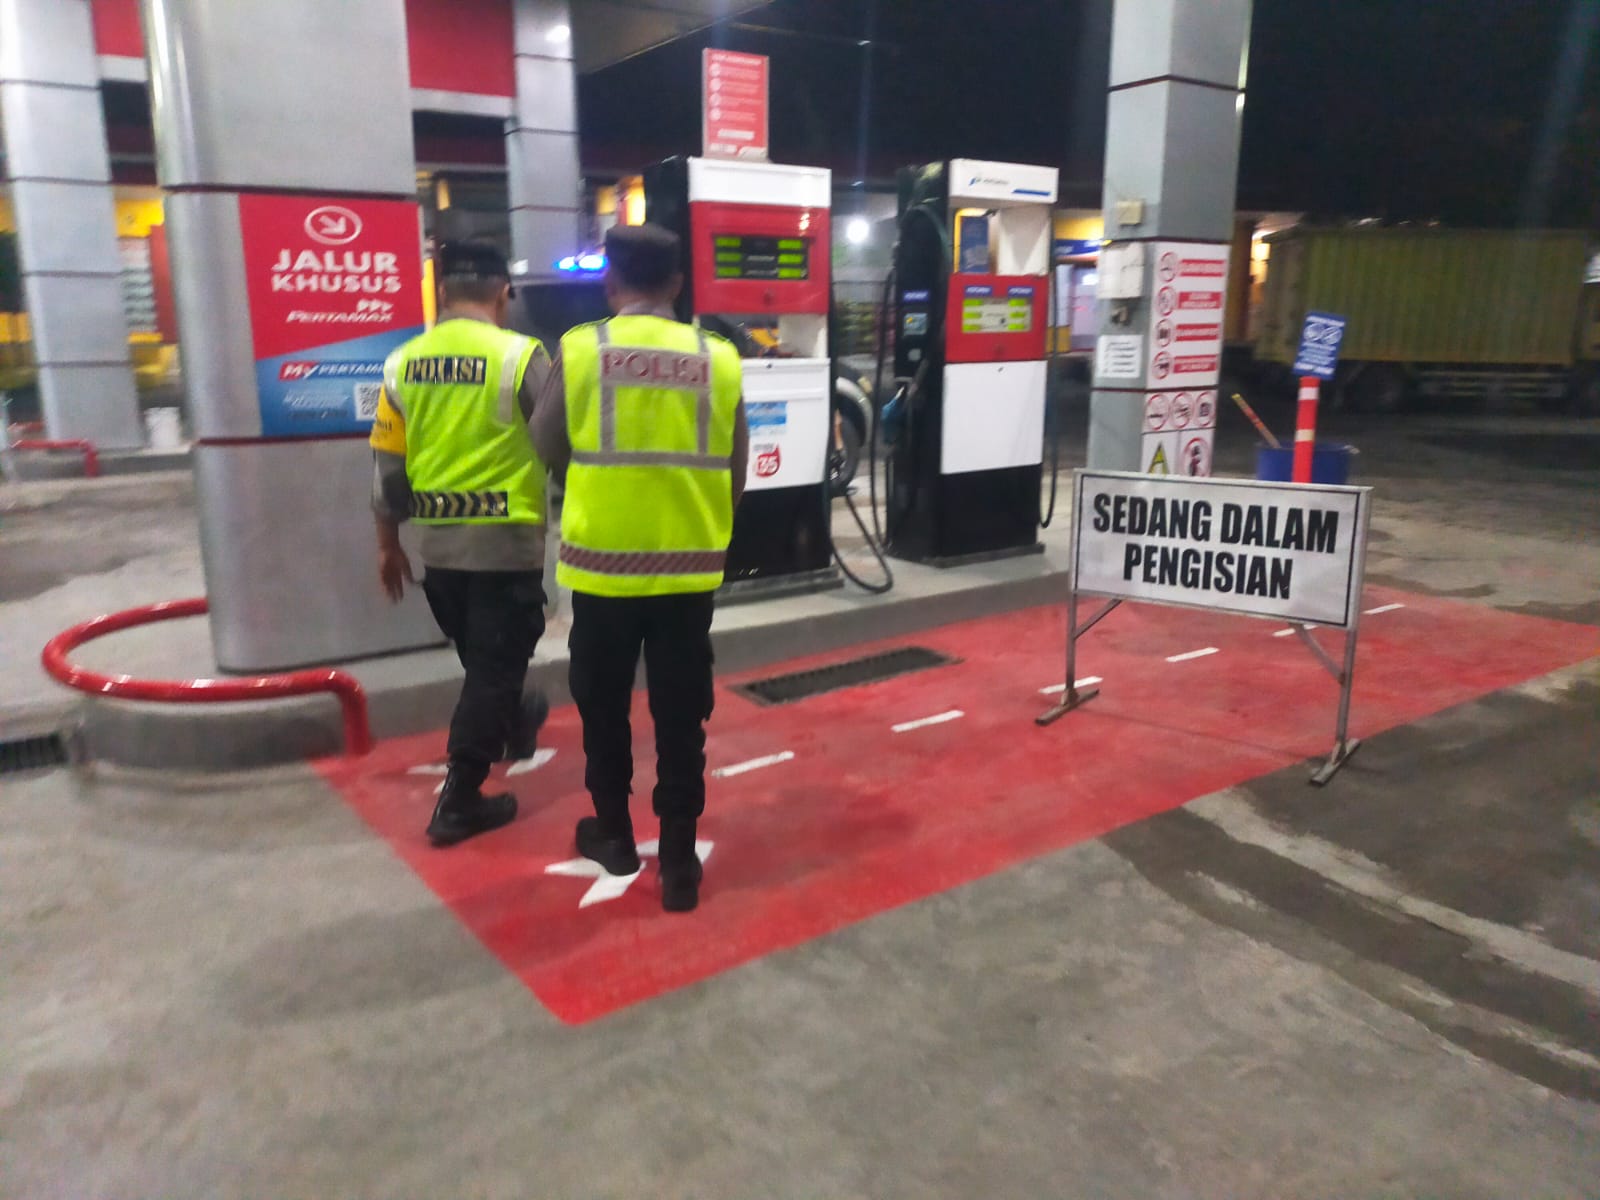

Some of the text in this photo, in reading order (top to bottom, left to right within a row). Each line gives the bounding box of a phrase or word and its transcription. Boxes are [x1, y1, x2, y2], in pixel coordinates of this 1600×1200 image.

[272, 249, 399, 274] JALUR
[272, 274, 401, 293] KHUSUS
[603, 350, 709, 384] POLISI
[1093, 493, 1339, 554] SEDANG DALAM
[1123, 543, 1293, 600] PENGISIAN
